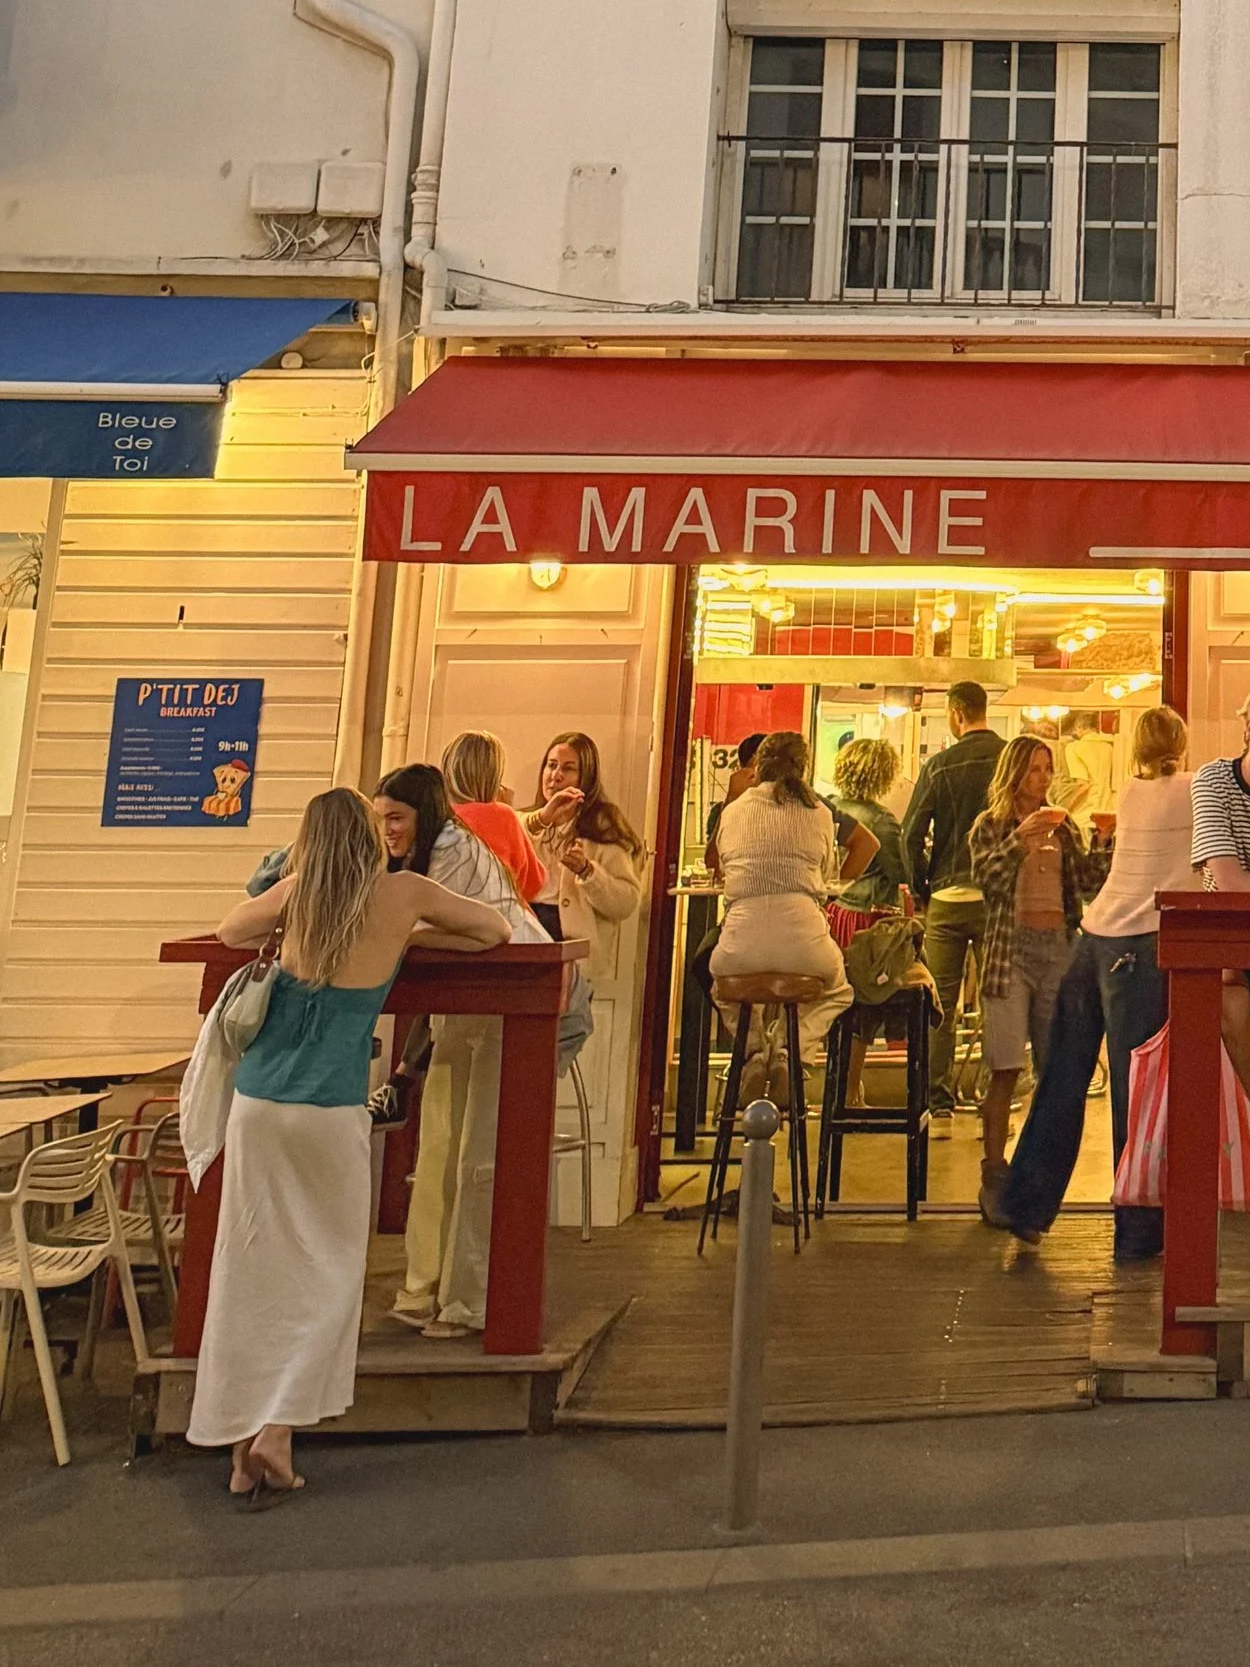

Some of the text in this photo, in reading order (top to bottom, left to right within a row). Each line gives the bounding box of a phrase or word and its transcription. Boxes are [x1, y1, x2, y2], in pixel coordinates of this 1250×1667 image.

[98, 412, 177, 429] Bleue
[115, 435, 153, 450] de
[113, 455, 149, 472] Toi
[400, 484, 987, 557] LA MARINE
[138, 683, 240, 706] P'TIT DEJ
[160, 707, 217, 718] BREAKFAST
